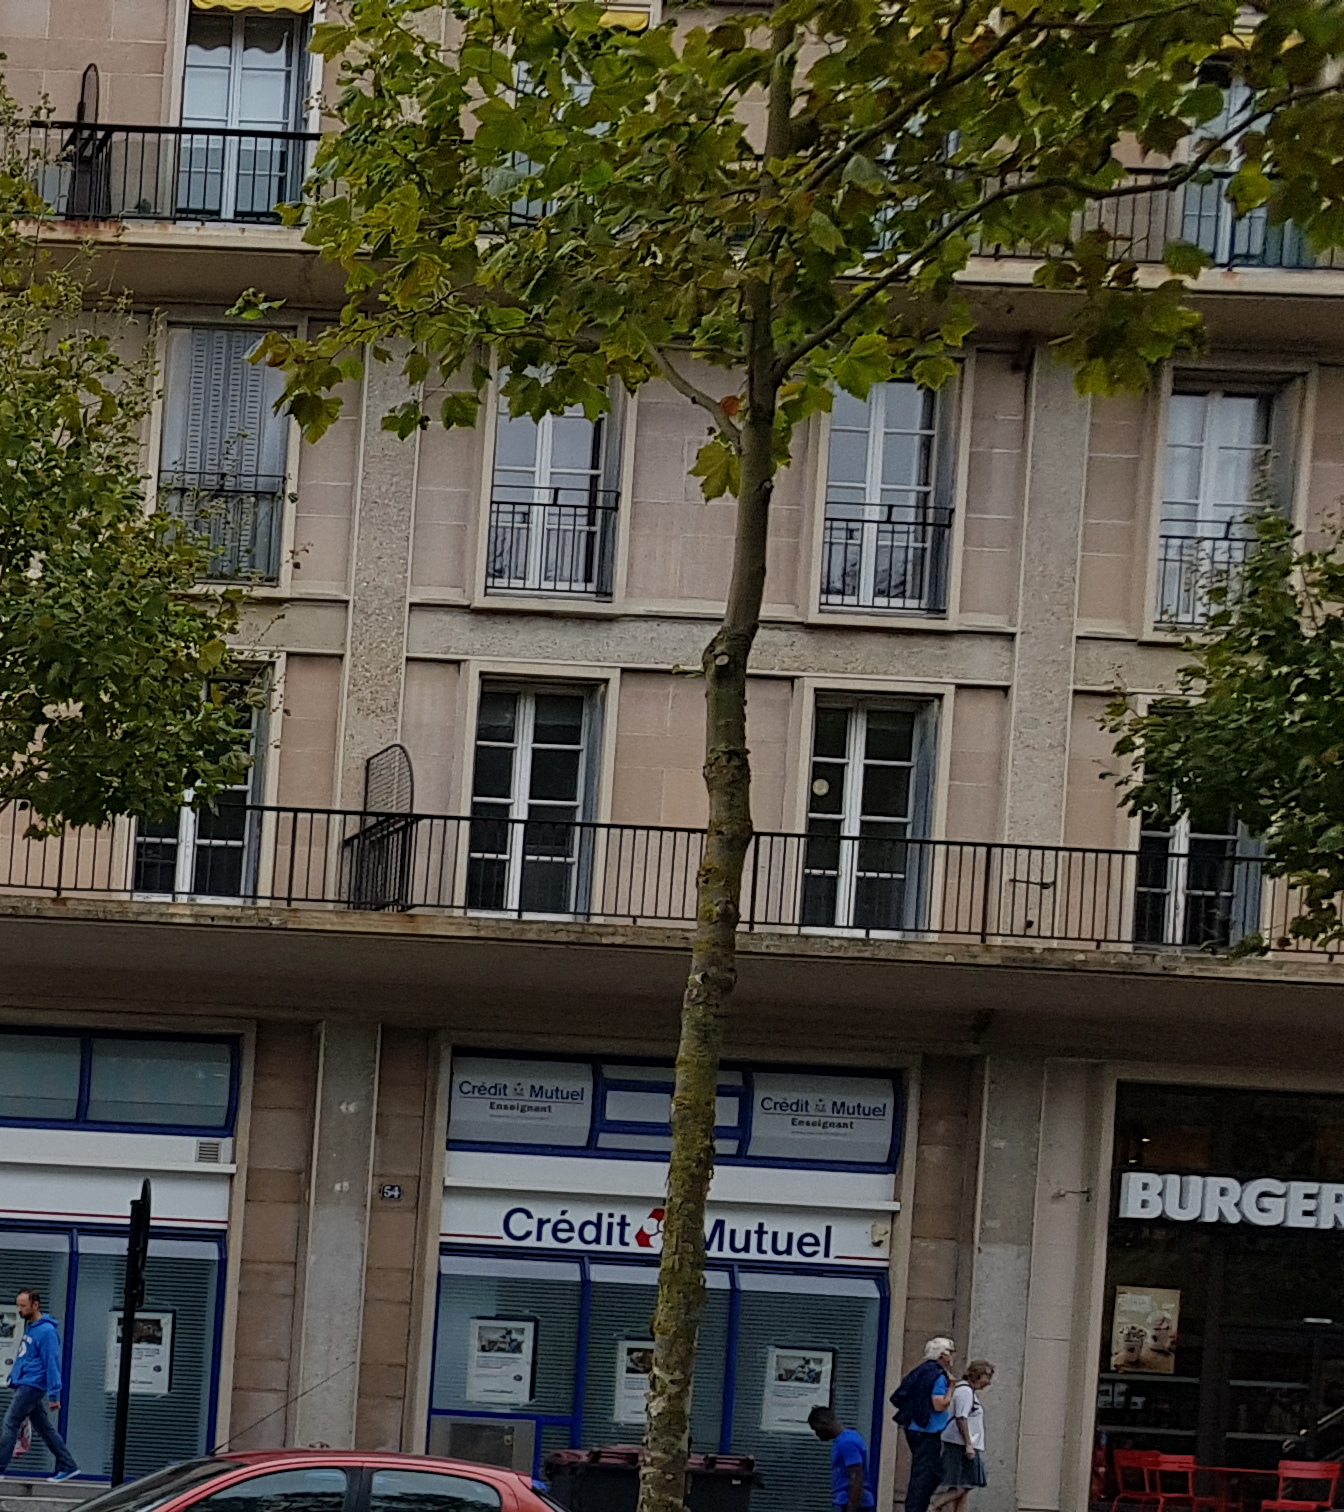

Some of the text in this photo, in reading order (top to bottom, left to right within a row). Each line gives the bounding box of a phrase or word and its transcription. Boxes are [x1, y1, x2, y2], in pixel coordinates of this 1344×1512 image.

[458, 1080, 585, 1101] Crédit Mutuel
[760, 1096, 887, 1117] Crédit Mutuel
[383, 1185, 400, 1198] 54
[1119, 1171, 1344, 1230] BURGER
[502, 1207, 631, 1247] Crédit
